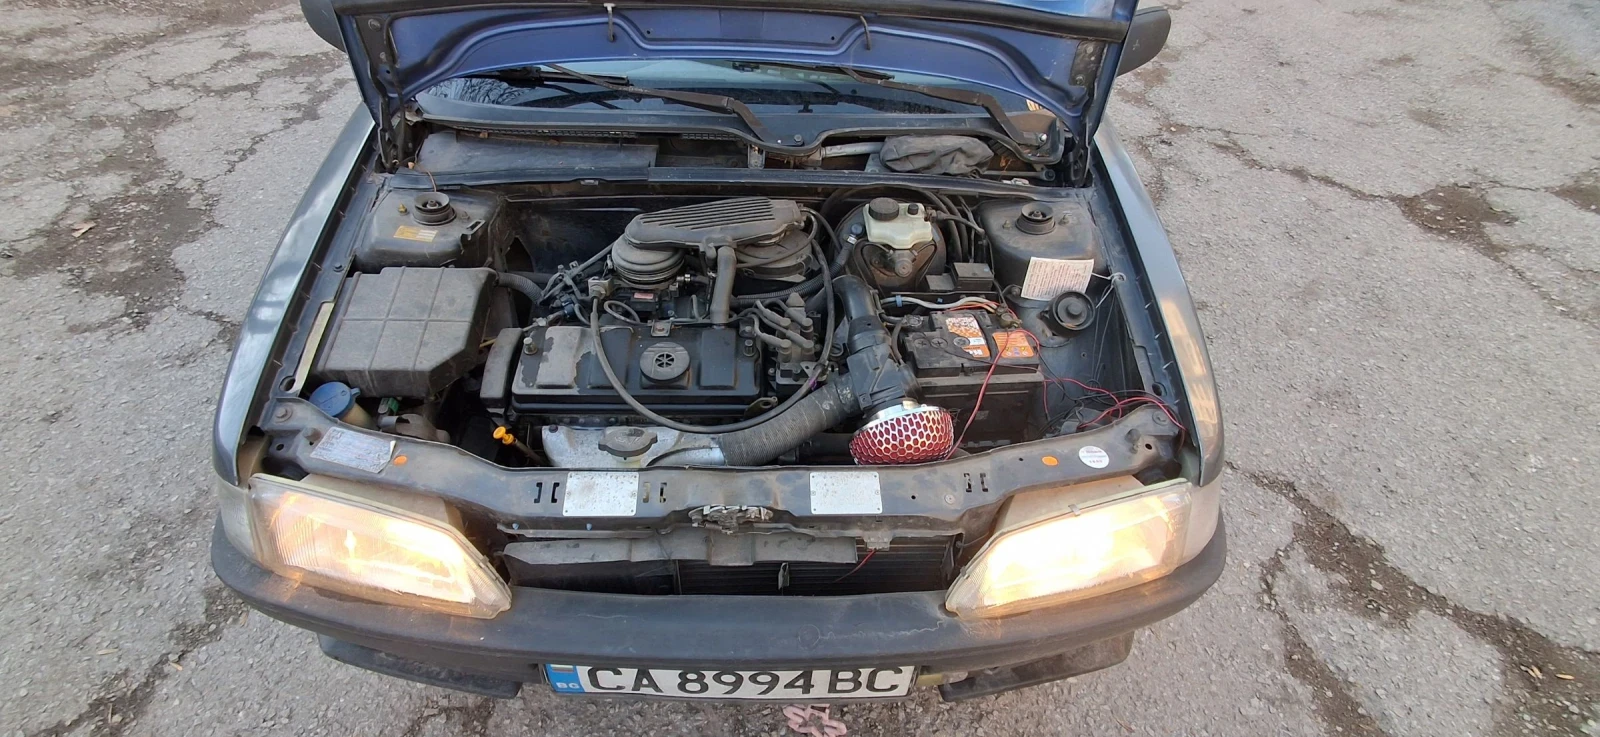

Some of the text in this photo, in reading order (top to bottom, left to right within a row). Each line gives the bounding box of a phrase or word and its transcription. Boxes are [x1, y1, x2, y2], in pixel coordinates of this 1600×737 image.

[587, 665, 903, 696] CA 8994 BC
